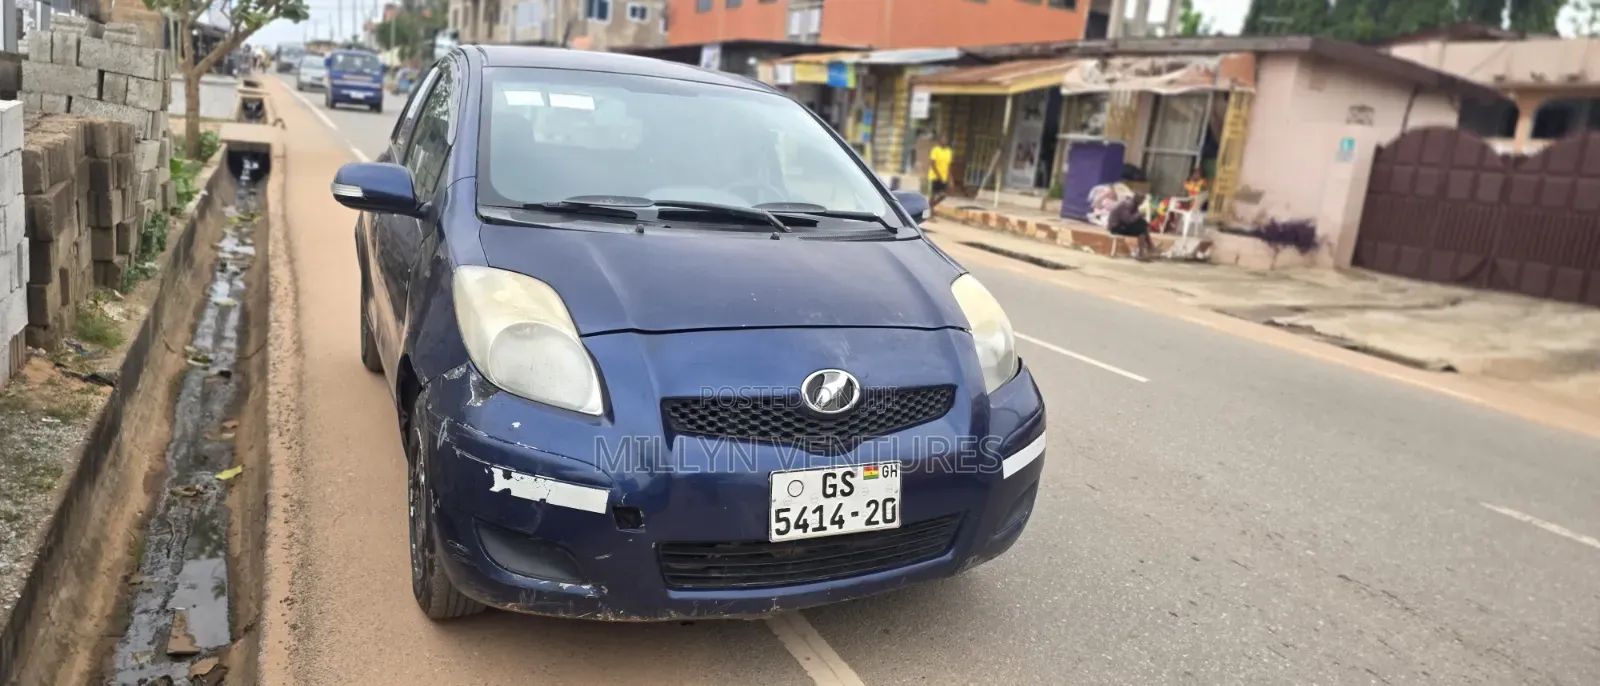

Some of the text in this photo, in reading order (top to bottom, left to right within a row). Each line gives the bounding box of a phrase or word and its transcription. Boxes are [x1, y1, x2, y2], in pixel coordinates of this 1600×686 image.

[821, 470, 855, 499] GS
[881, 464, 898, 478] GH
[774, 497, 897, 536] 5414-20
